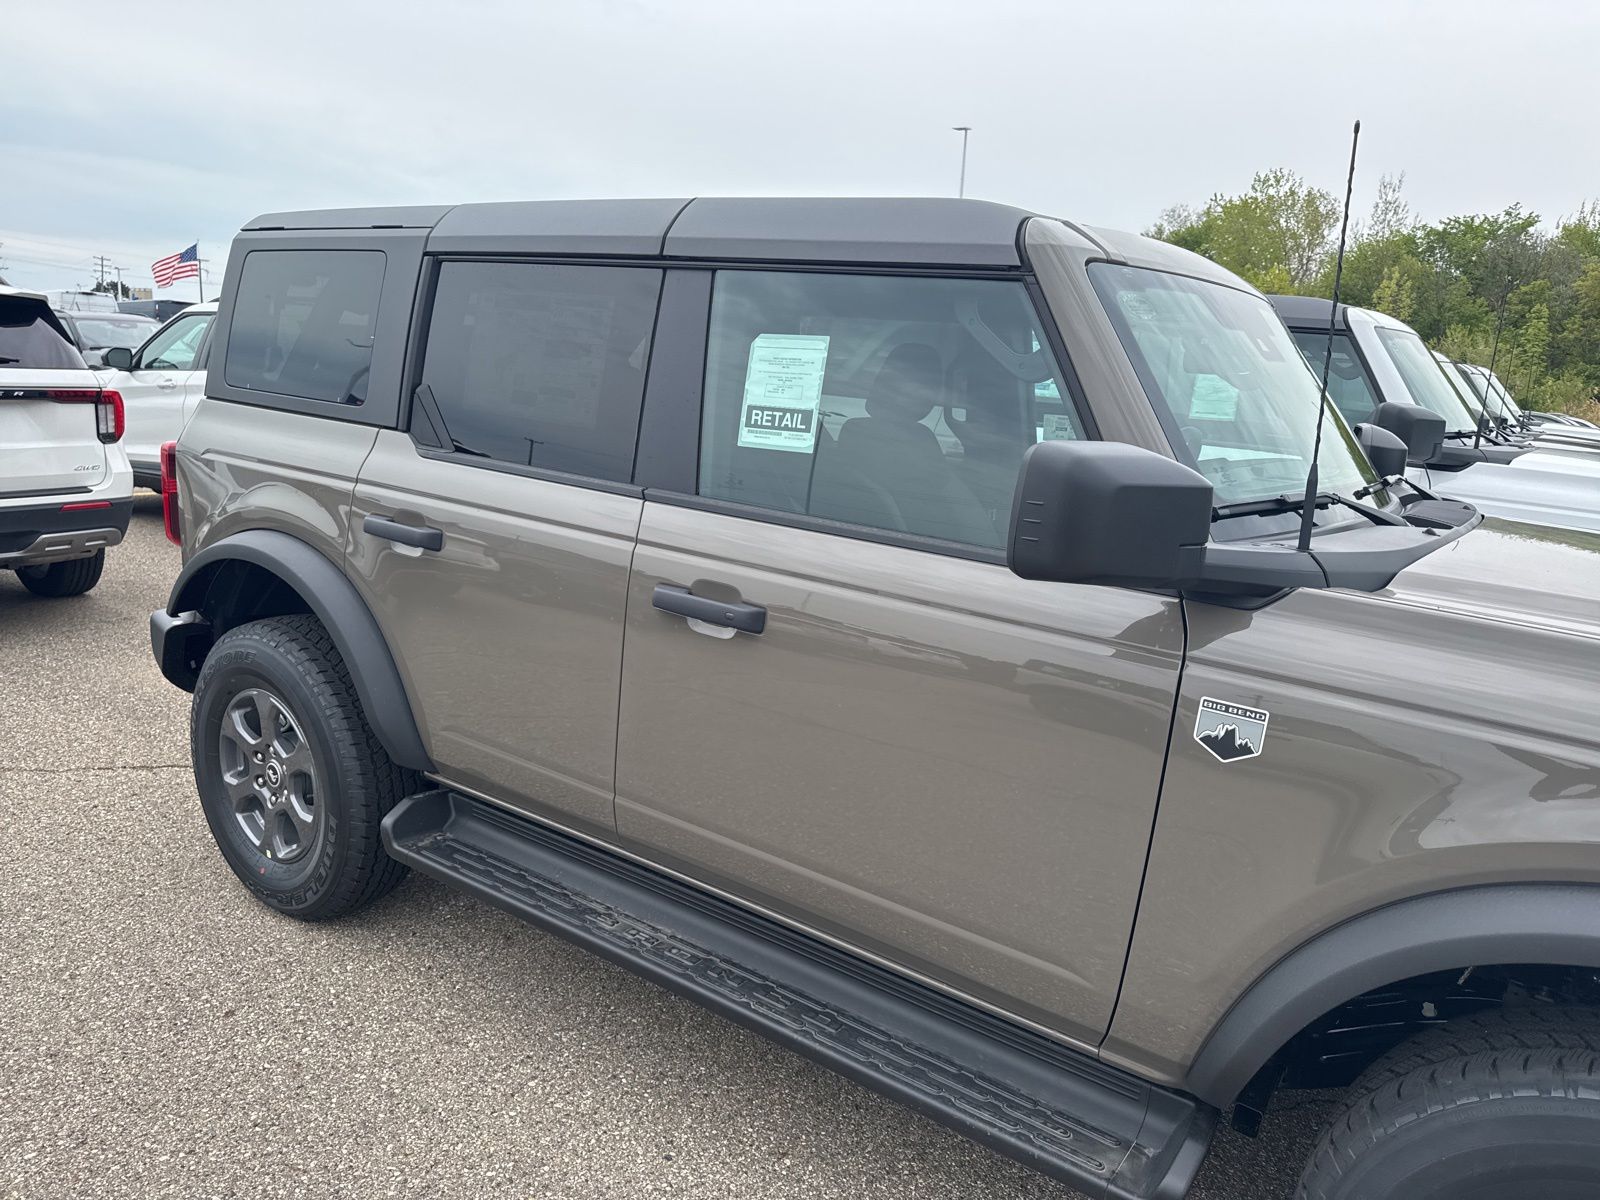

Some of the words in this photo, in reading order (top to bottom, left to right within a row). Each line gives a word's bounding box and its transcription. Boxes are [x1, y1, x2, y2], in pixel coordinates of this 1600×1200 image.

[750, 409, 806, 430] RETAIL
[1203, 700, 1226, 712] BIG
[1228, 706, 1266, 721] BEND
